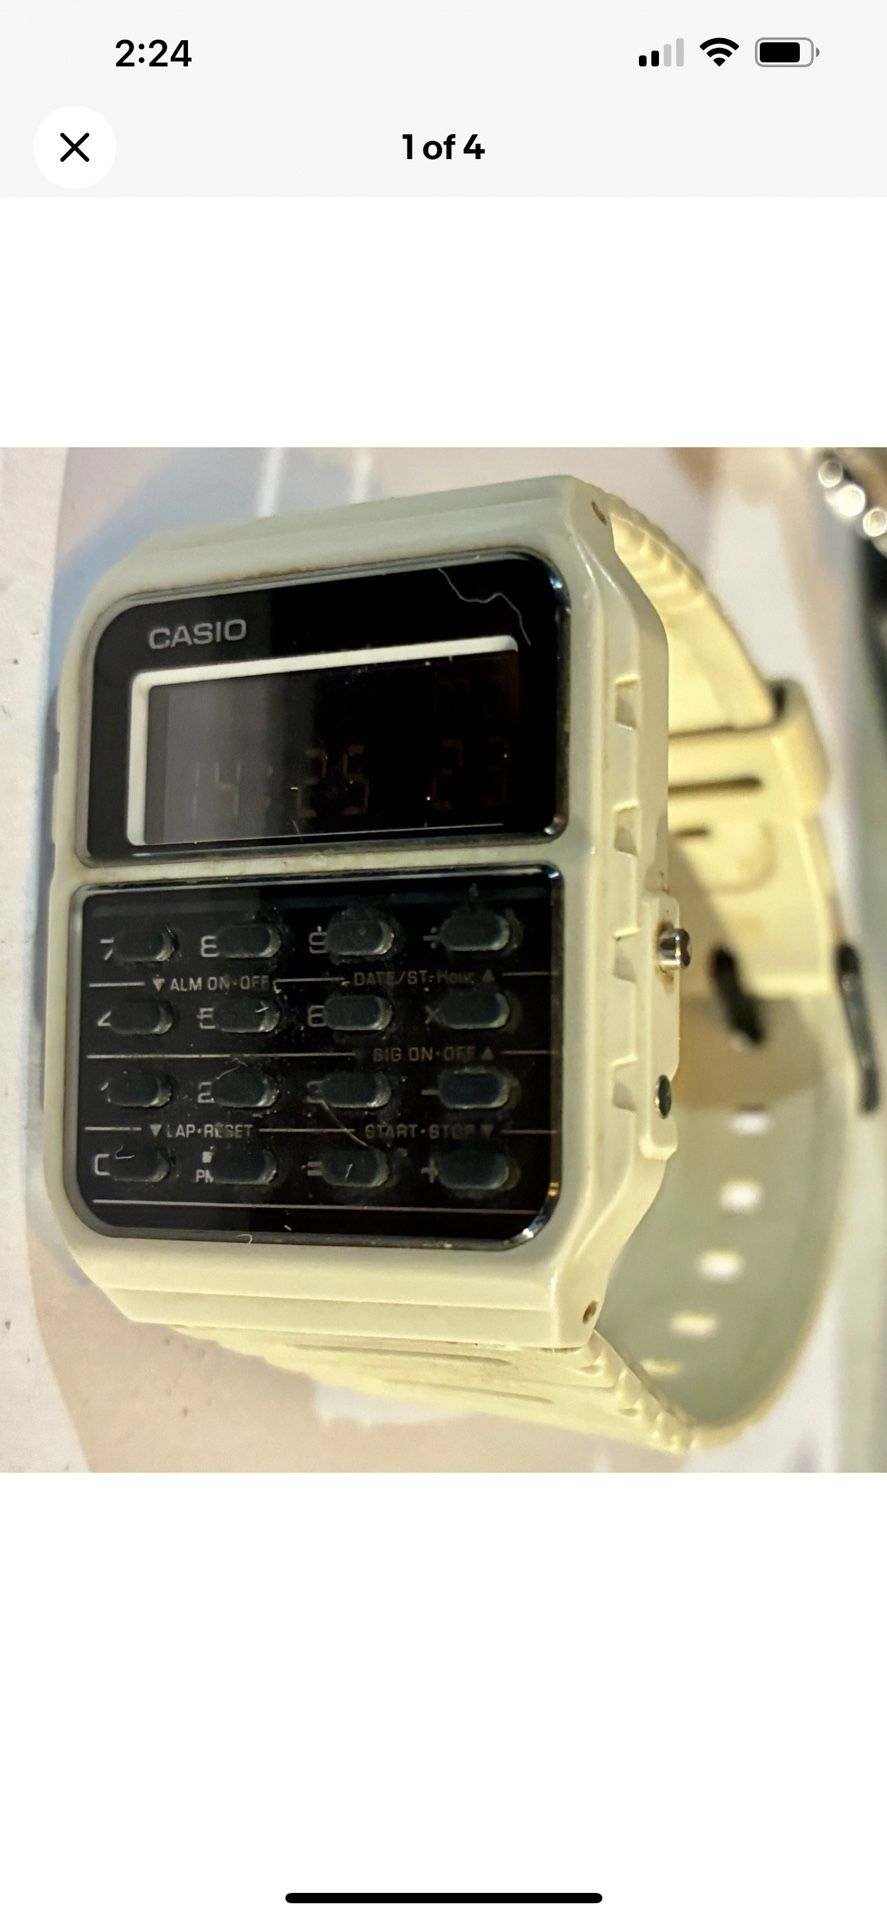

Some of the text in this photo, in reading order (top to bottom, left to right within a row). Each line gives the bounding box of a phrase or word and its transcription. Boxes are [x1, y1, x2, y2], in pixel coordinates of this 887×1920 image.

[148, 618, 247, 650] CASIO
[169, 978, 202, 992] ALM
[372, 1046, 401, 1062] SIG
